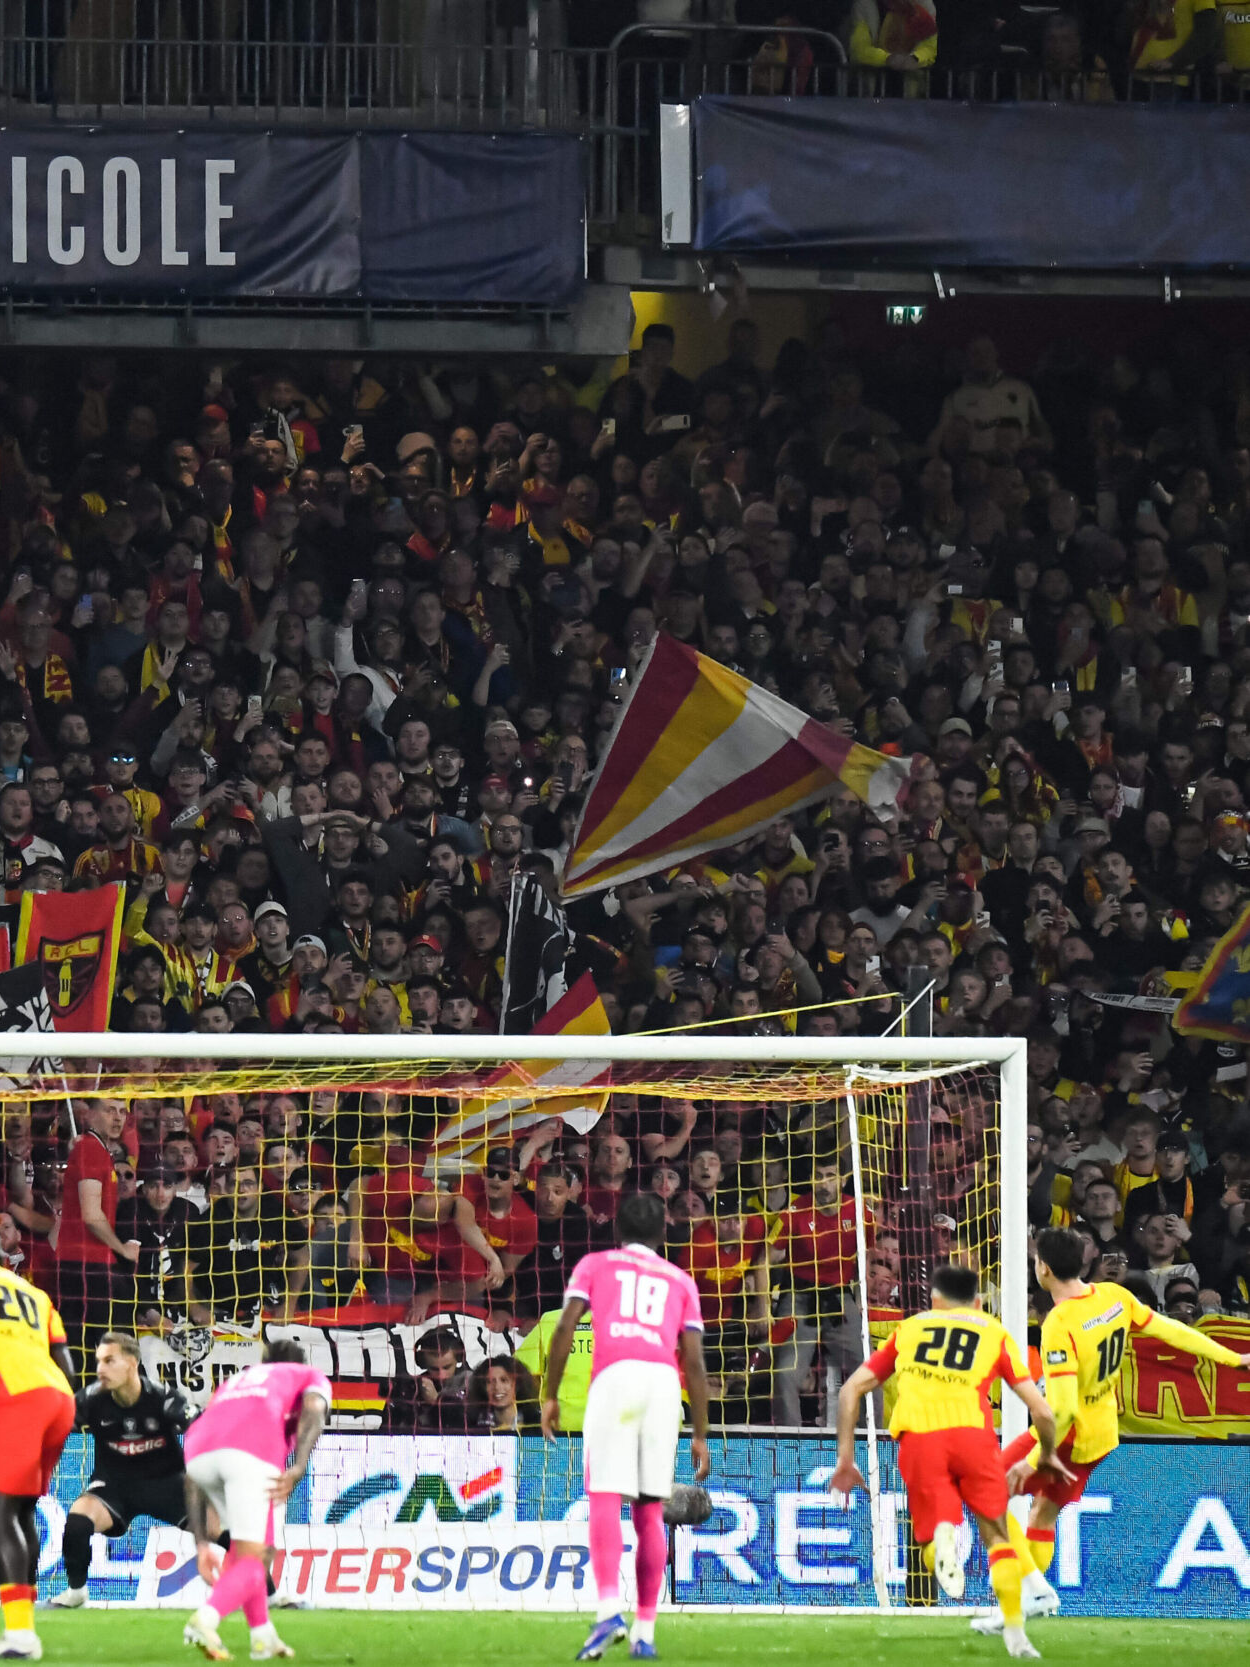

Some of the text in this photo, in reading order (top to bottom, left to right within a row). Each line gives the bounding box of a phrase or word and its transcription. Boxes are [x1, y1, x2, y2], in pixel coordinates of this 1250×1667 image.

[614, 1269, 670, 1327] 18
[913, 1326, 981, 1371] 28
[1096, 1326, 1126, 1383] 10
[263, 1543, 633, 1595] TERSPOR
